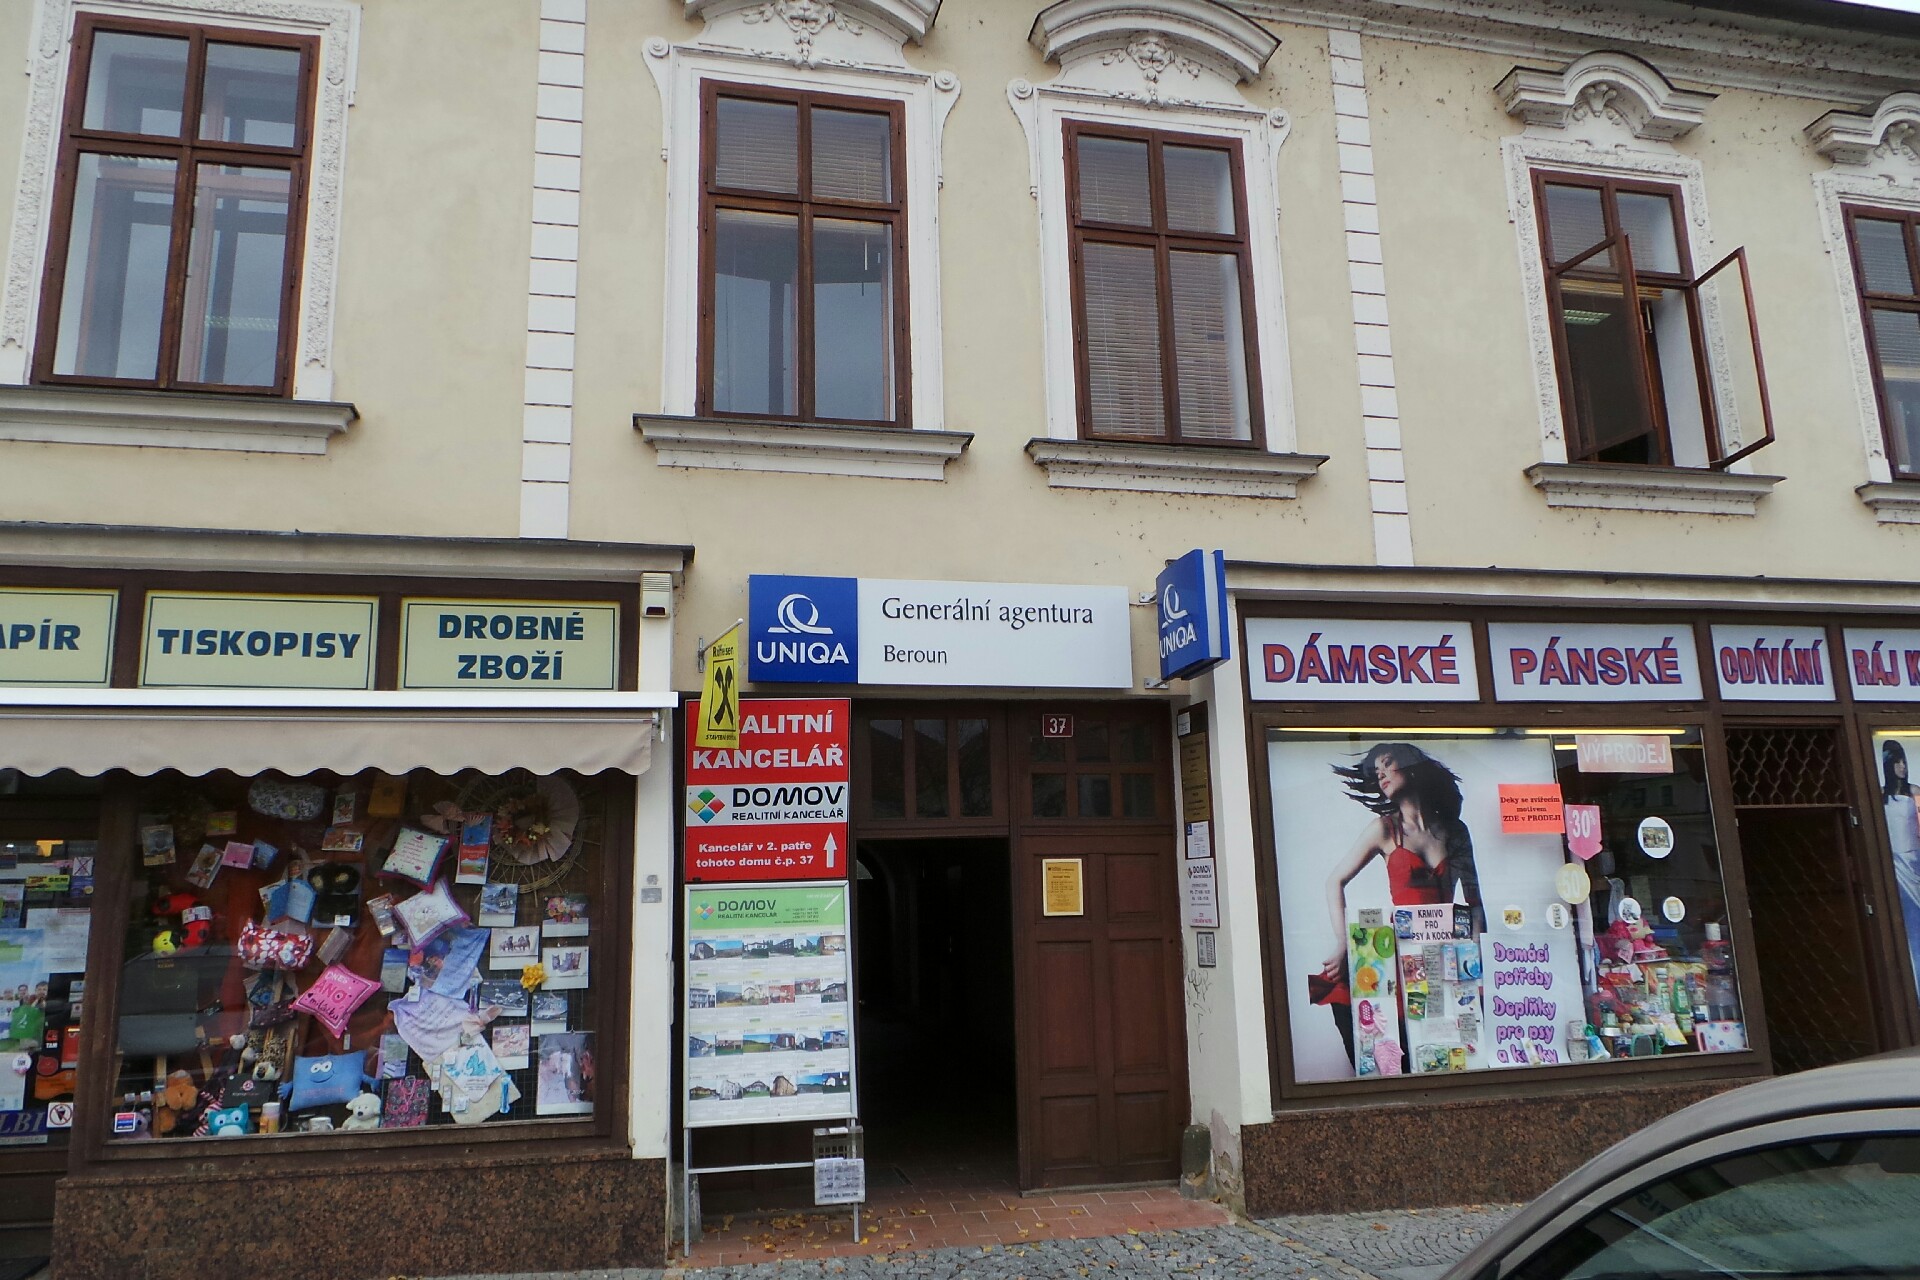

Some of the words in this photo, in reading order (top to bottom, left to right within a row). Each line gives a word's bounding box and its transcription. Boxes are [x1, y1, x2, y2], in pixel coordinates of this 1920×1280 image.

[881, 597, 991, 621] Generální
[999, 604, 1093, 630] agentura
[0, 618, 81, 650] PÍR
[438, 611, 585, 642] DROBNÉ
[157, 628, 361, 659] TISKOPISY
[1160, 622, 1198, 658] UNIQA
[456, 650, 563, 681] ZBOŽÍ
[757, 641, 850, 666] UNIQA
[883, 645, 948, 665] Beroun
[1263, 632, 1461, 684] DÁMSKÉ
[1512, 636, 1683, 686] PÁNSKÉ
[1719, 638, 1825, 687] ODÍVÁNÍ
[1851, 641, 1901, 687] RÁJ
[738, 710, 833, 734] ALITNÍ
[1049, 717, 1067, 734] 37
[692, 743, 844, 769] KANCELÁŘ
[1581, 738, 1667, 765] VÝPRODEJ
[732, 785, 844, 808] DOMOV
[1500, 796, 1519, 804] Deky
[731, 810, 781, 821] REALITNÍ
[783, 807, 844, 820] KANCELÁŘ
[1527, 814, 1561, 822] PRODEJI
[698, 842, 753, 853] Kancelář
[766, 842, 778, 851] 2.
[781, 841, 812, 853] patře
[695, 857, 736, 868] tohoto
[738, 856, 771, 866] domu
[774, 856, 796, 867] č.p.
[799, 855, 814, 865] 37
[718, 900, 777, 911] DOMOV
[1417, 908, 1444, 918] KRMIVO
[1411, 932, 1424, 940] PSY
[1426, 932, 1431, 940] A
[1424, 920, 1439, 929] PRO
[1494, 966, 1553, 990] potřeby
[1492, 995, 1556, 1021] Doplňky
[1496, 1025, 1525, 1044] pro
[1528, 1025, 1554, 1044] psy
[1496, 1049, 1509, 1063] a
[1510, 1043, 1559, 1064] kky
